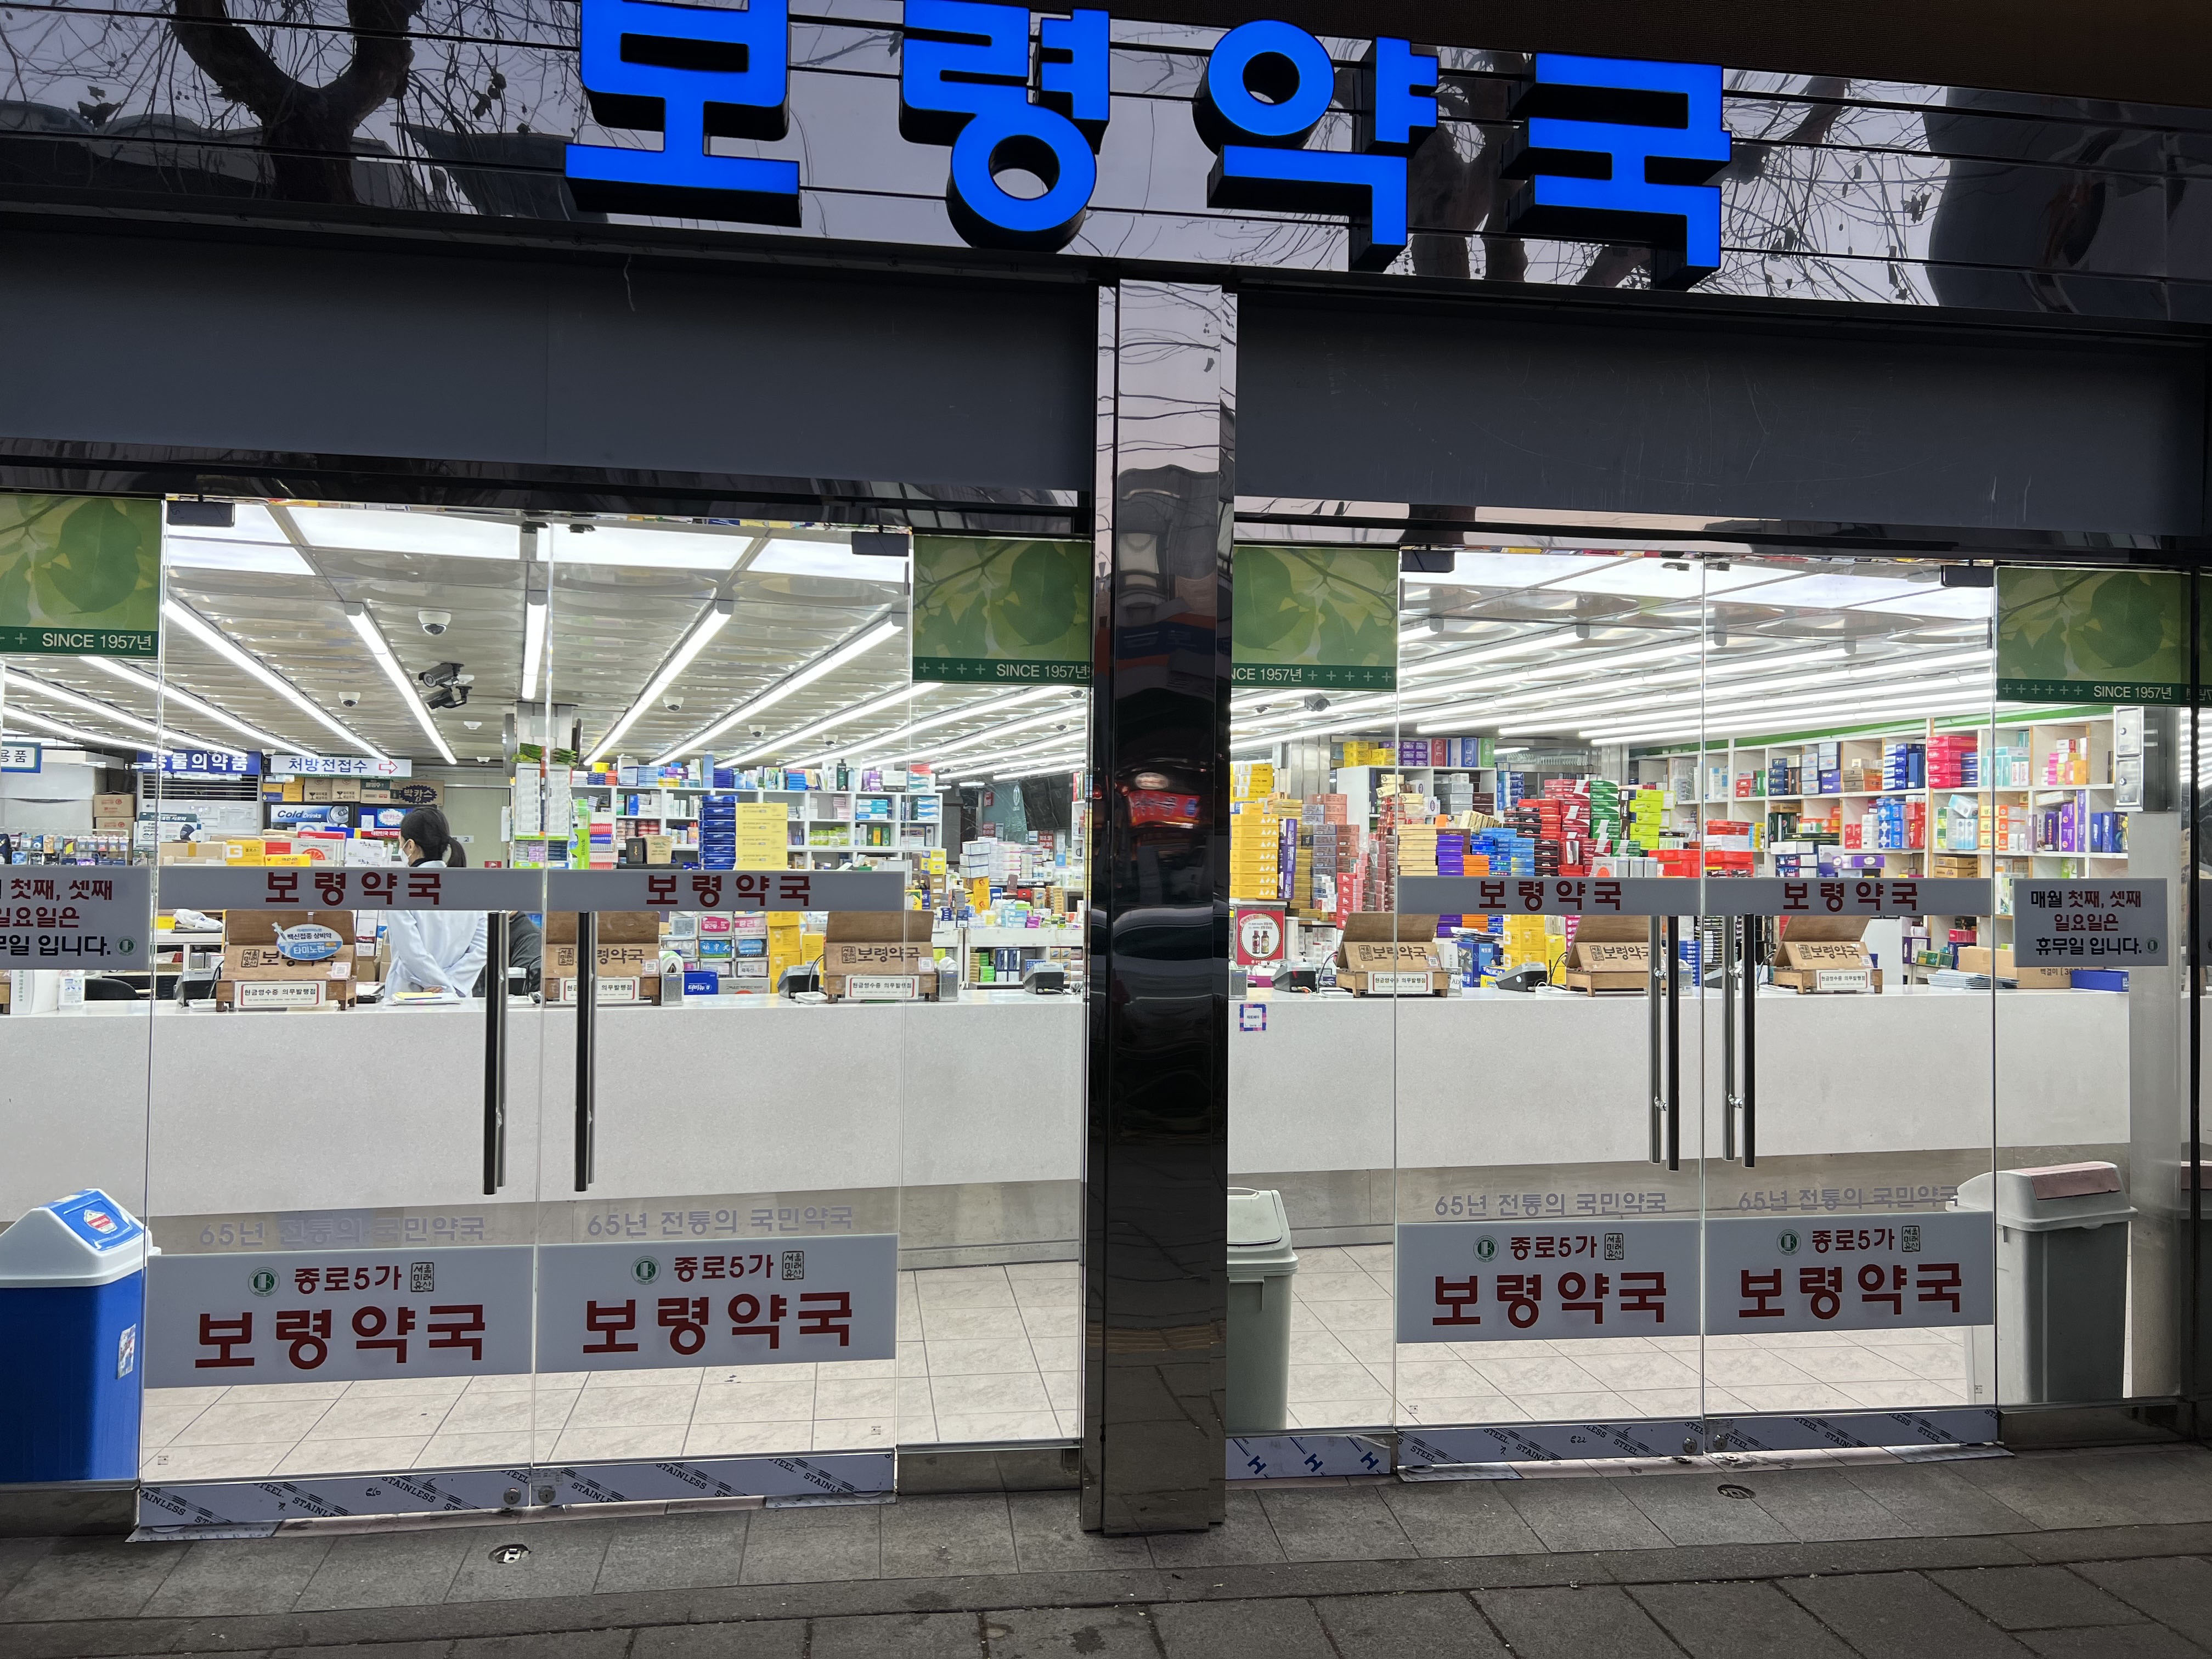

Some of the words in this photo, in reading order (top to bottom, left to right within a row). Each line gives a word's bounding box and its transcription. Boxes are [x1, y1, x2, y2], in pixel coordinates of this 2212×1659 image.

[566, 0, 1732, 268] 보령약국
[42, 631, 94, 649] SINCE
[99, 634, 153, 652] 1957년
[996, 663, 1040, 678] SINCE
[1045, 664, 1088, 681] 1957년
[1260, 668, 1302, 684] 1957년
[2094, 685, 2131, 698] SINCE
[2135, 686, 2172, 700] 1957년
[289, 758, 368, 773] 처방전접수
[403, 788, 433, 798] 박카스
[277, 810, 304, 819] Cold
[10, 878, 60, 902] 첫째,
[69, 879, 113, 901] 셋째
[266, 871, 441, 906] 보령약국
[646, 874, 811, 908] 보령약국
[1479, 880, 1622, 912] 보령약국
[1783, 881, 1918, 913] 보령약국
[2030, 890, 2063, 909] 매월
[2068, 890, 2105, 909] 첫째,
[2109, 890, 2142, 908] 셋째
[2054, 913, 2119, 932] 일요일은
[38, 935, 111, 957] 입니다.
[293, 944, 326, 953] 타미노펜
[857, 946, 921, 962] 보령약국
[1810, 945, 1860, 959] 보령약국
[2036, 937, 2084, 956] 휴무일
[2089, 937, 2142, 956] 입니다.
[2040, 968, 2058, 976] 벽걸이
[1435, 1193, 1487, 1217] 65년
[1498, 1193, 1566, 1216] 전통의
[1576, 1191, 1667, 1216] 국민약국
[1737, 1188, 1788, 1212] 65년
[1799, 1187, 1863, 1211] 전통의
[1872, 1184, 1959, 1209] 국민약국
[199, 1219, 264, 1246] 65년
[278, 1216, 362, 1244] 전통의
[374, 1214, 486, 1244] 국민약국
[587, 1210, 648, 1237] 65년
[660, 1208, 738, 1235] 전통의
[749, 1205, 853, 1233] 국민약국
[1606, 1235, 1622, 1244] 서울
[1811, 1227, 1895, 1254] 종로5가
[1904, 1227, 1918, 1235] 서울
[1509, 1235, 1598, 1261] 종로5가
[1607, 1249, 1622, 1259] 유산
[1904, 1242, 1918, 1250] 유산
[785, 1252, 802, 1262] 서울
[785, 1261, 802, 1269] 미래
[413, 1264, 432, 1273] 서울
[413, 1273, 432, 1282] 미래
[674, 1253, 774, 1283] 종로5가
[785, 1269, 803, 1278] 유산
[294, 1265, 402, 1295] 종로5가
[414, 1280, 432, 1290] 유산
[1432, 1271, 1667, 1329] 보령약국
[1738, 1263, 1962, 1320] 보령약국
[582, 1291, 853, 1356] 보령약국
[195, 1304, 486, 1370] 보령약국
[1613, 1438, 1640, 1457] STEEL.
